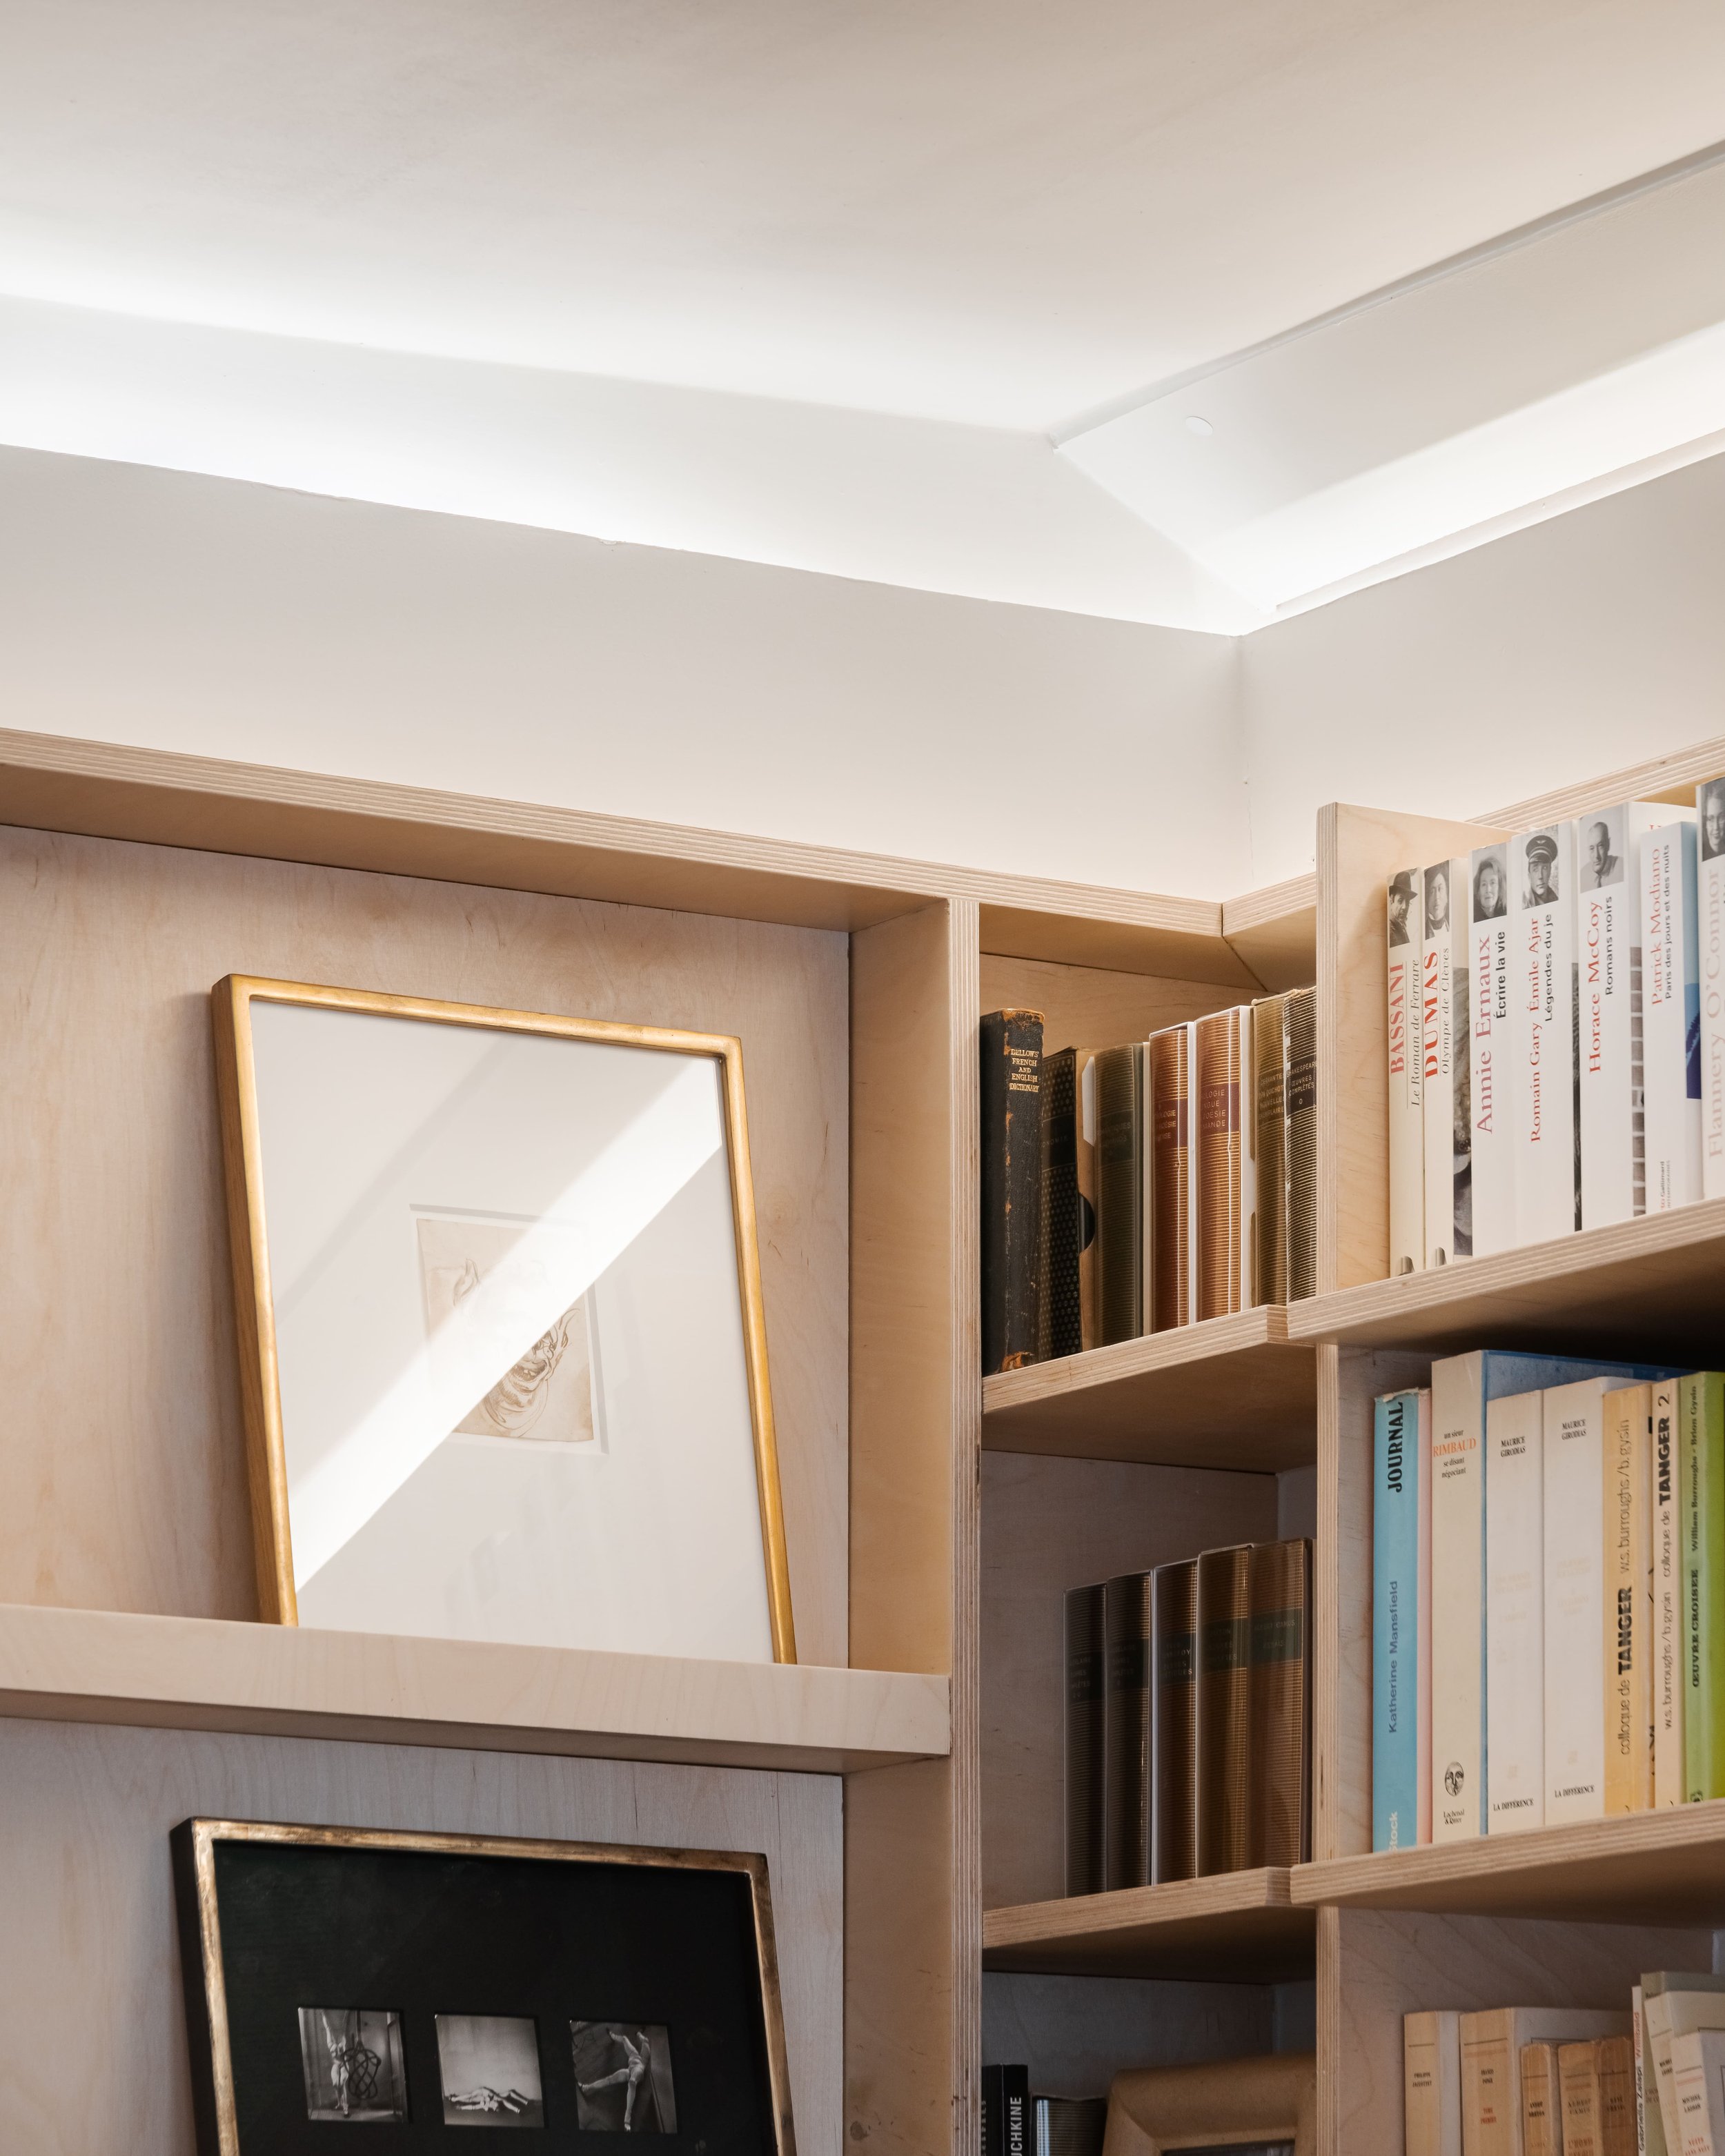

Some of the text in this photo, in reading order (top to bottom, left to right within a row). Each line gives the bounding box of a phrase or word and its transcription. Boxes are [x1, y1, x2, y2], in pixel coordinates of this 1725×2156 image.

[1649, 849, 1663, 1005] Patrick Modiano
[1664, 900, 1670, 911] et
[1664, 915, 1673, 950] jours
[1493, 931, 1506, 1019] Écrire la vie
[1544, 913, 1554, 1022] Légendes du je
[1587, 900, 1602, 1075] Horace McCoy
[1605, 936, 1613, 996] Romans
[1390, 962, 1404, 1074] BASSANI
[1410, 960, 1419, 1106] Le Roman de Ferrare
[1423, 951, 1438, 1080] DUMAS
[1441, 948, 1451, 1074] Olympe de Clèves
[1476, 934, 1492, 1134] Annie Ernaux
[1526, 918, 1542, 1143] Romain Gary Émile Ajar
[1009, 1083, 1039, 1092] DICTIONARY
[1012, 1058, 1037, 1067] FRENCH
[1012, 1073, 1038, 1082] ENGLISH
[1289, 1082, 1314, 1096] COMPLÈTES
[1708, 1034, 1725, 1157] Flannery
[1561, 1419, 1586, 1430] MAURICE
[1658, 1393, 1670, 1407] 2
[1388, 1401, 1403, 1493] JOURNAL
[1433, 1438, 1476, 1457] RIMBAUD
[1500, 1445, 1526, 1457] GIRODIAS
[1501, 1436, 1525, 1447] MAURICE
[1561, 1430, 1586, 1441] GIRODIAS
[1658, 1416, 1670, 1506] TANGER
[1691, 1456, 1699, 1507] Burroughs
[1661, 1511, 1670, 1525] de
[1659, 1530, 1670, 1578] colloque
[1617, 1585, 1632, 1676] TANGER
[1389, 1581, 1398, 1734] Katherine Mansfield
[1617, 1679, 1630, 1697] de
[1617, 1699, 1631, 1755] colloque
[1493, 1803, 1501, 1811] LA
[1554, 1790, 1562, 1798] LA
[1010, 2097, 1022, 2156] UCHKINE
